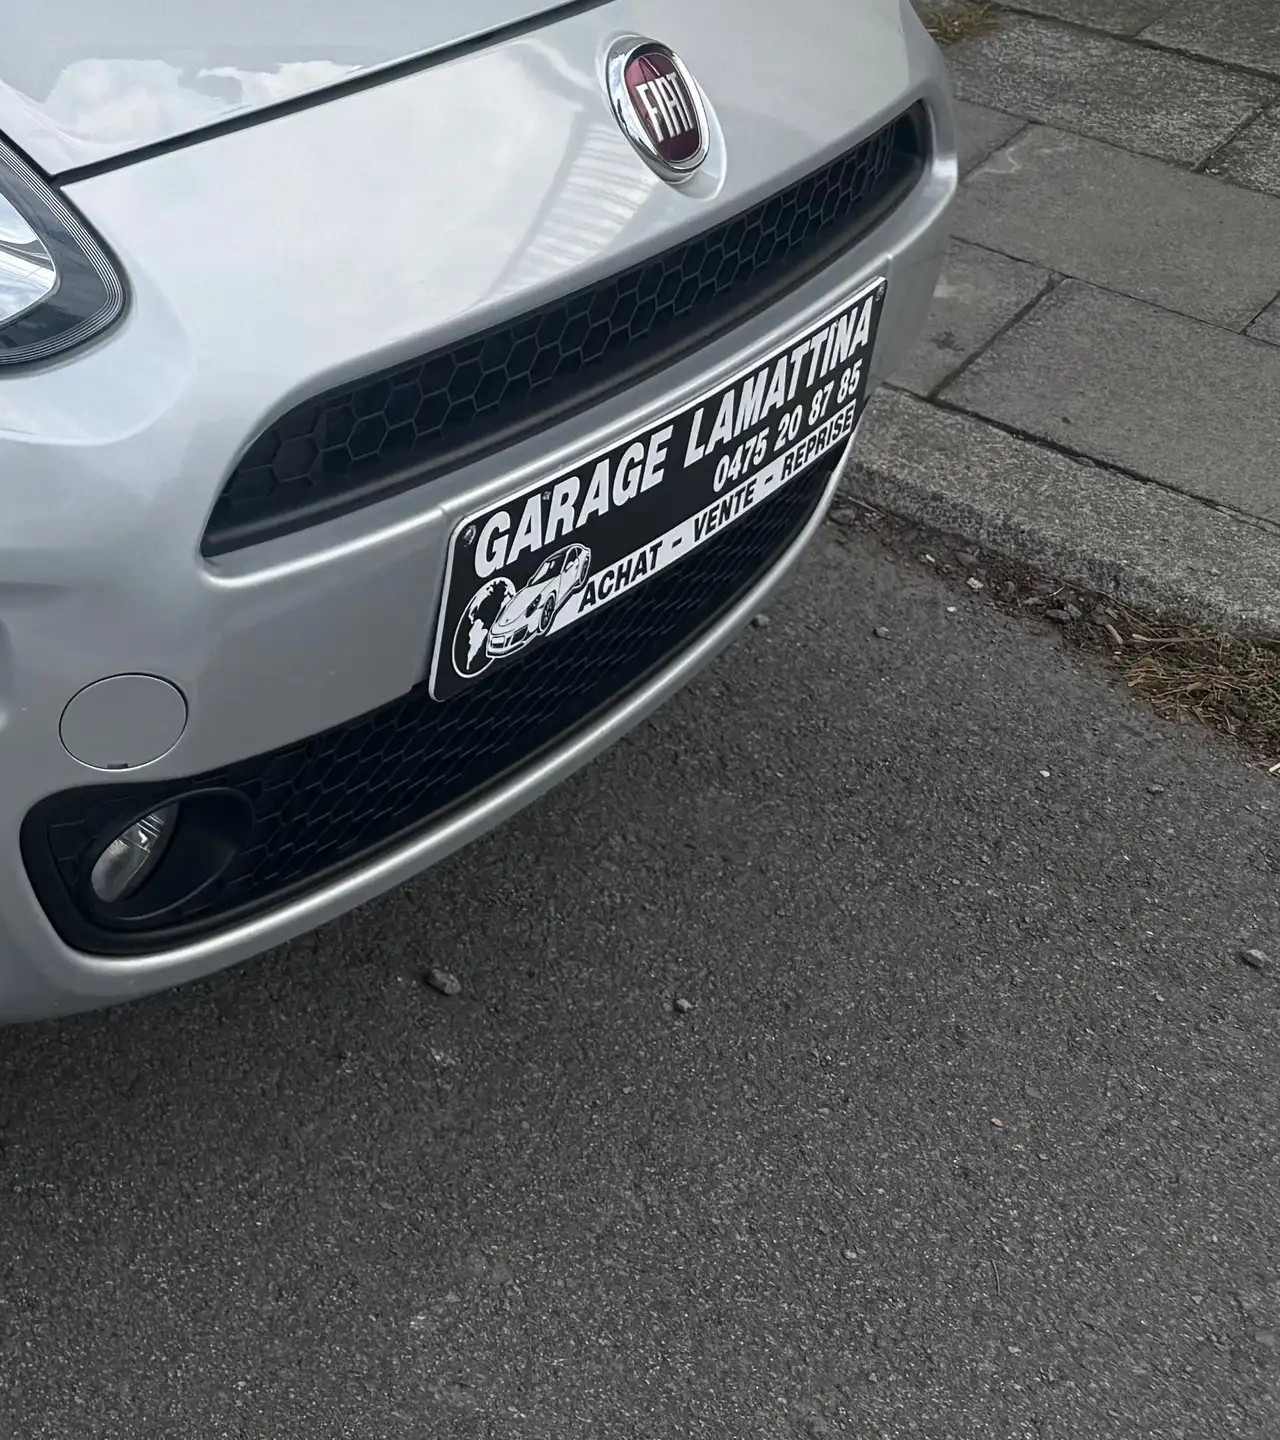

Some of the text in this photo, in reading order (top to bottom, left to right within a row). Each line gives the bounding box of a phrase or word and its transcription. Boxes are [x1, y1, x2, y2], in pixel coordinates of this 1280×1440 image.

[635, 72, 694, 143] FIAT
[474, 296, 873, 579] GARAGE LAMATTINA
[578, 540, 663, 612] ACHAT
[693, 479, 757, 542] VENTE
[781, 408, 854, 482] REPRISE
[713, 358, 863, 493] 0475 20 87 85
